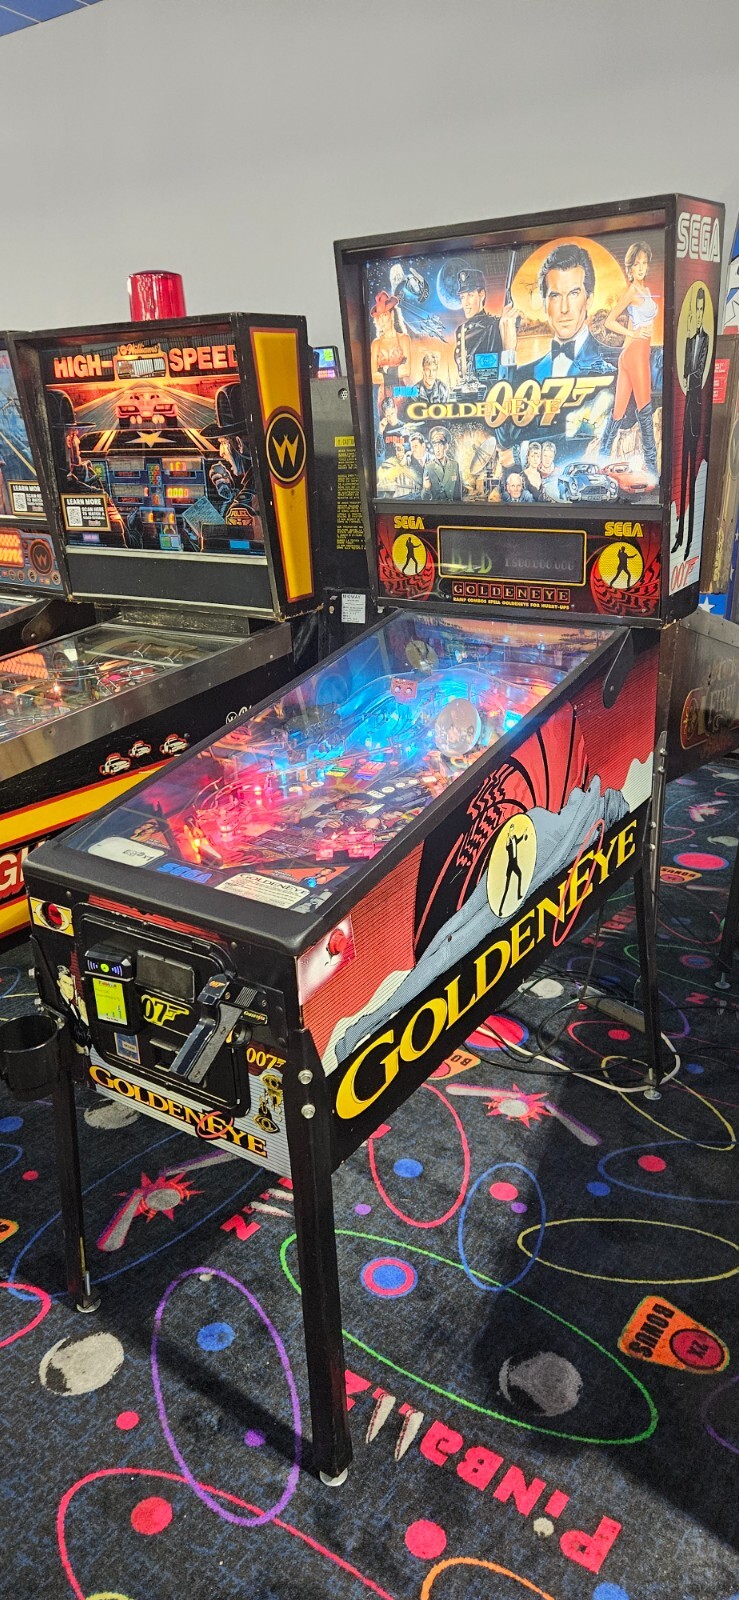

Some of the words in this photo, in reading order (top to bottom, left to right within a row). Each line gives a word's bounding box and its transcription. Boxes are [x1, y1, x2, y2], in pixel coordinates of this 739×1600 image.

[676, 211, 721, 263] SEGA
[484, 376, 614, 428] 007
[66, 498, 85, 506] LEARN
[85, 498, 102, 506] MORE
[393, 515, 425, 530] SEGA
[604, 521, 644, 538] SEGA
[453, 583, 570, 601] GOLDENEYE
[156, 862, 213, 884] SEGA
[336, 819, 638, 1120] GOLDENEYE
[246, 1047, 281, 1070] 007
[89, 1065, 268, 1159] GOLDENEYE
[628, 1303, 675, 1358] BONUS
